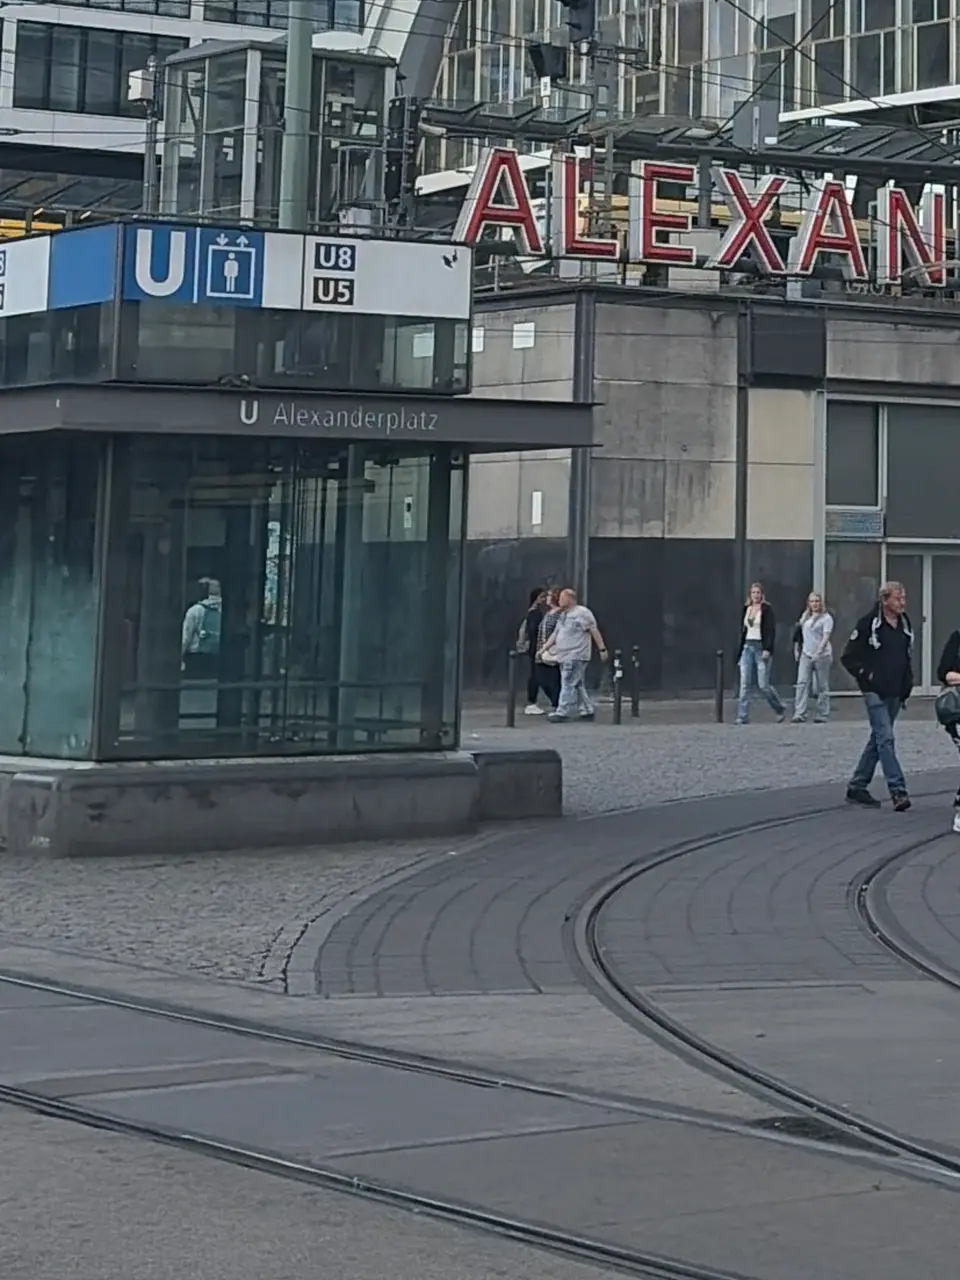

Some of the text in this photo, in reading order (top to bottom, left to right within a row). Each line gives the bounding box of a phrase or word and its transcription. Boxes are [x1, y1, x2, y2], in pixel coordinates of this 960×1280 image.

[135, 228, 186, 297] U
[319, 245, 353, 269] U8
[317, 279, 351, 303] U5
[240, 400, 439, 434] U Alexanderplatz
